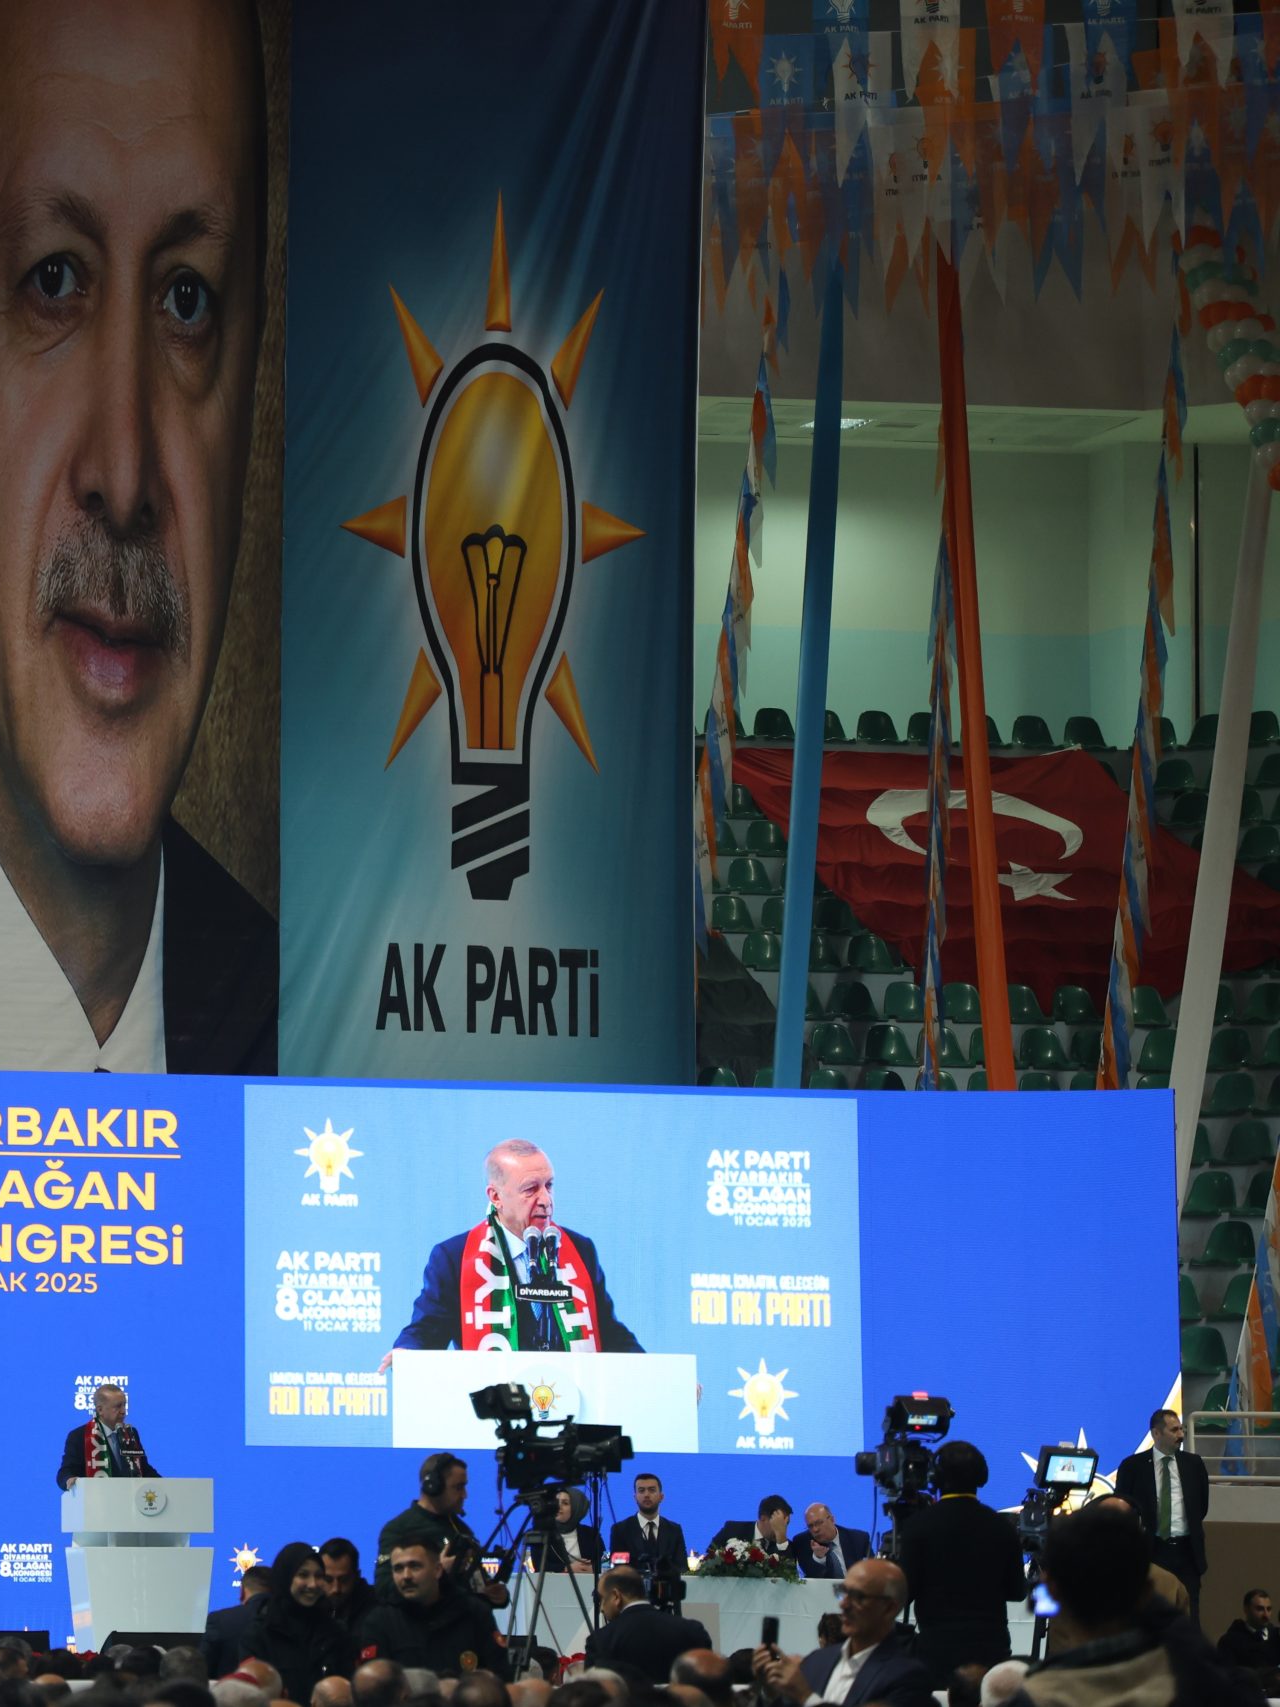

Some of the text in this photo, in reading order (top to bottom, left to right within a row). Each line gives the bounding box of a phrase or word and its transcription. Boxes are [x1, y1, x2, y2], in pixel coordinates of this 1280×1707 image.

[376, 942, 446, 1032] AK
[707, 1149, 740, 1169] AK
[301, 1193, 321, 1206] AK
[276, 1250, 310, 1271] AK
[35, 1272, 98, 1294] 2025
[519, 1286, 570, 1297] DİYARBAKIR
[691, 1290, 727, 1325] ADI
[732, 1291, 762, 1326] AK
[75, 1375, 92, 1386] AK
[269, 1386, 301, 1416] ADI
[304, 1386, 330, 1416] AK
[736, 1435, 756, 1449] AK
[0, 1543, 17, 1553] AK
